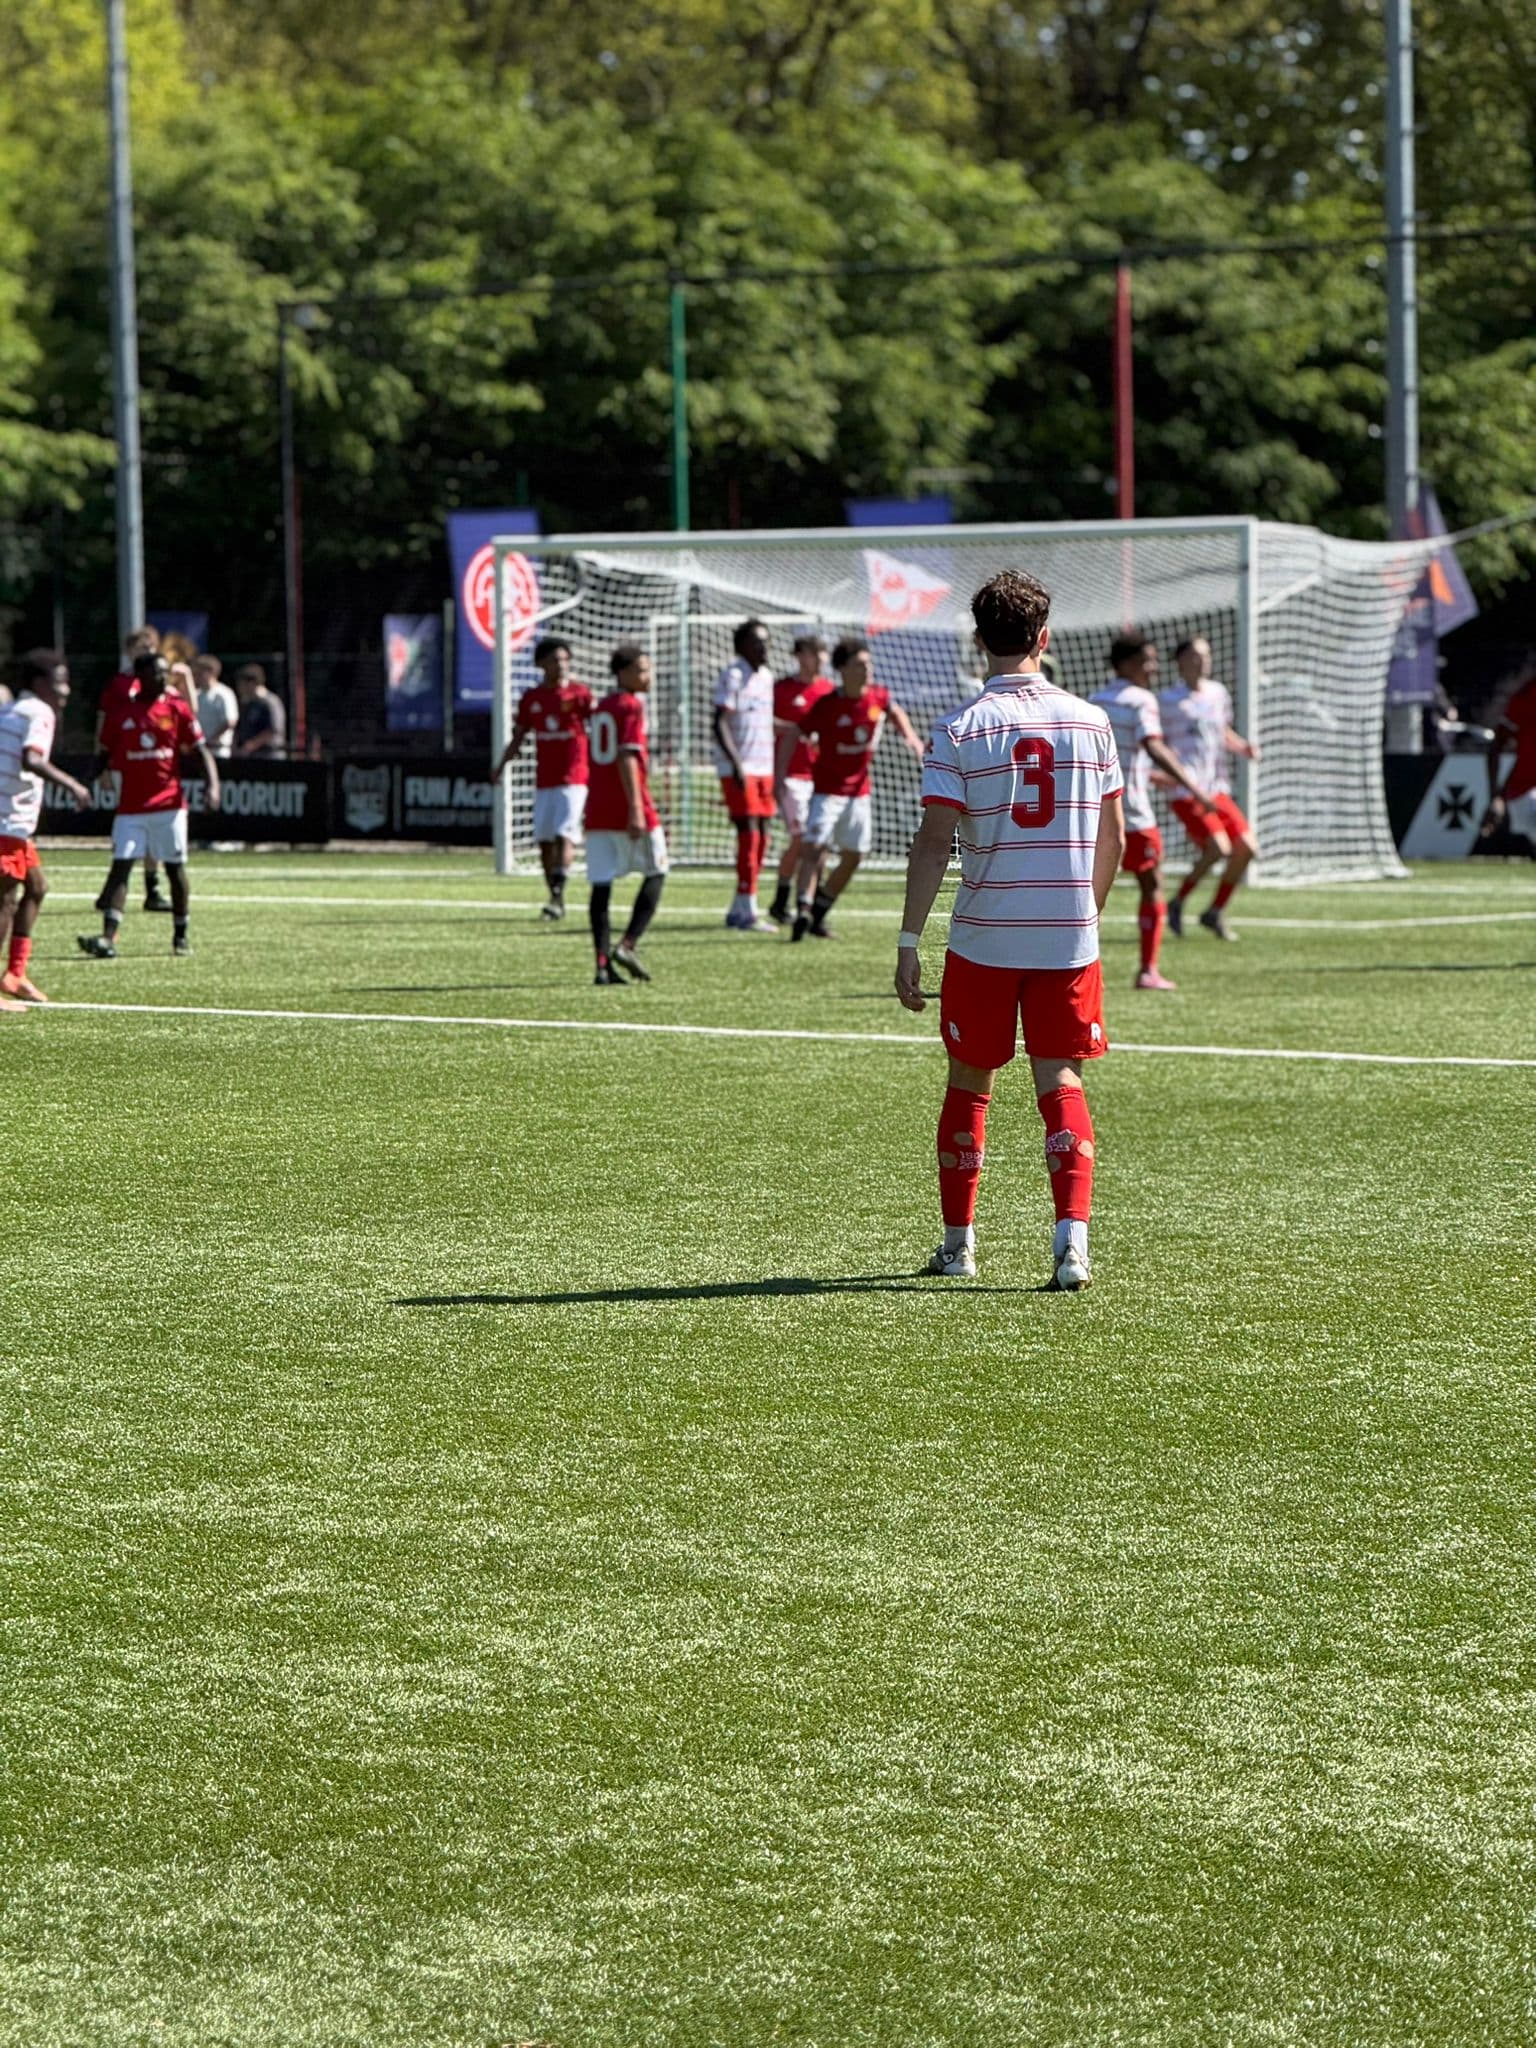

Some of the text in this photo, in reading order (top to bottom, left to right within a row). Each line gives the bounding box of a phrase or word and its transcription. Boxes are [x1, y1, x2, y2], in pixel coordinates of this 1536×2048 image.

[586, 711, 617, 765] 0
[221, 780, 308, 817] OORUIT
[405, 776, 492, 807] FUN Aca
[1011, 737, 1055, 829] 3
